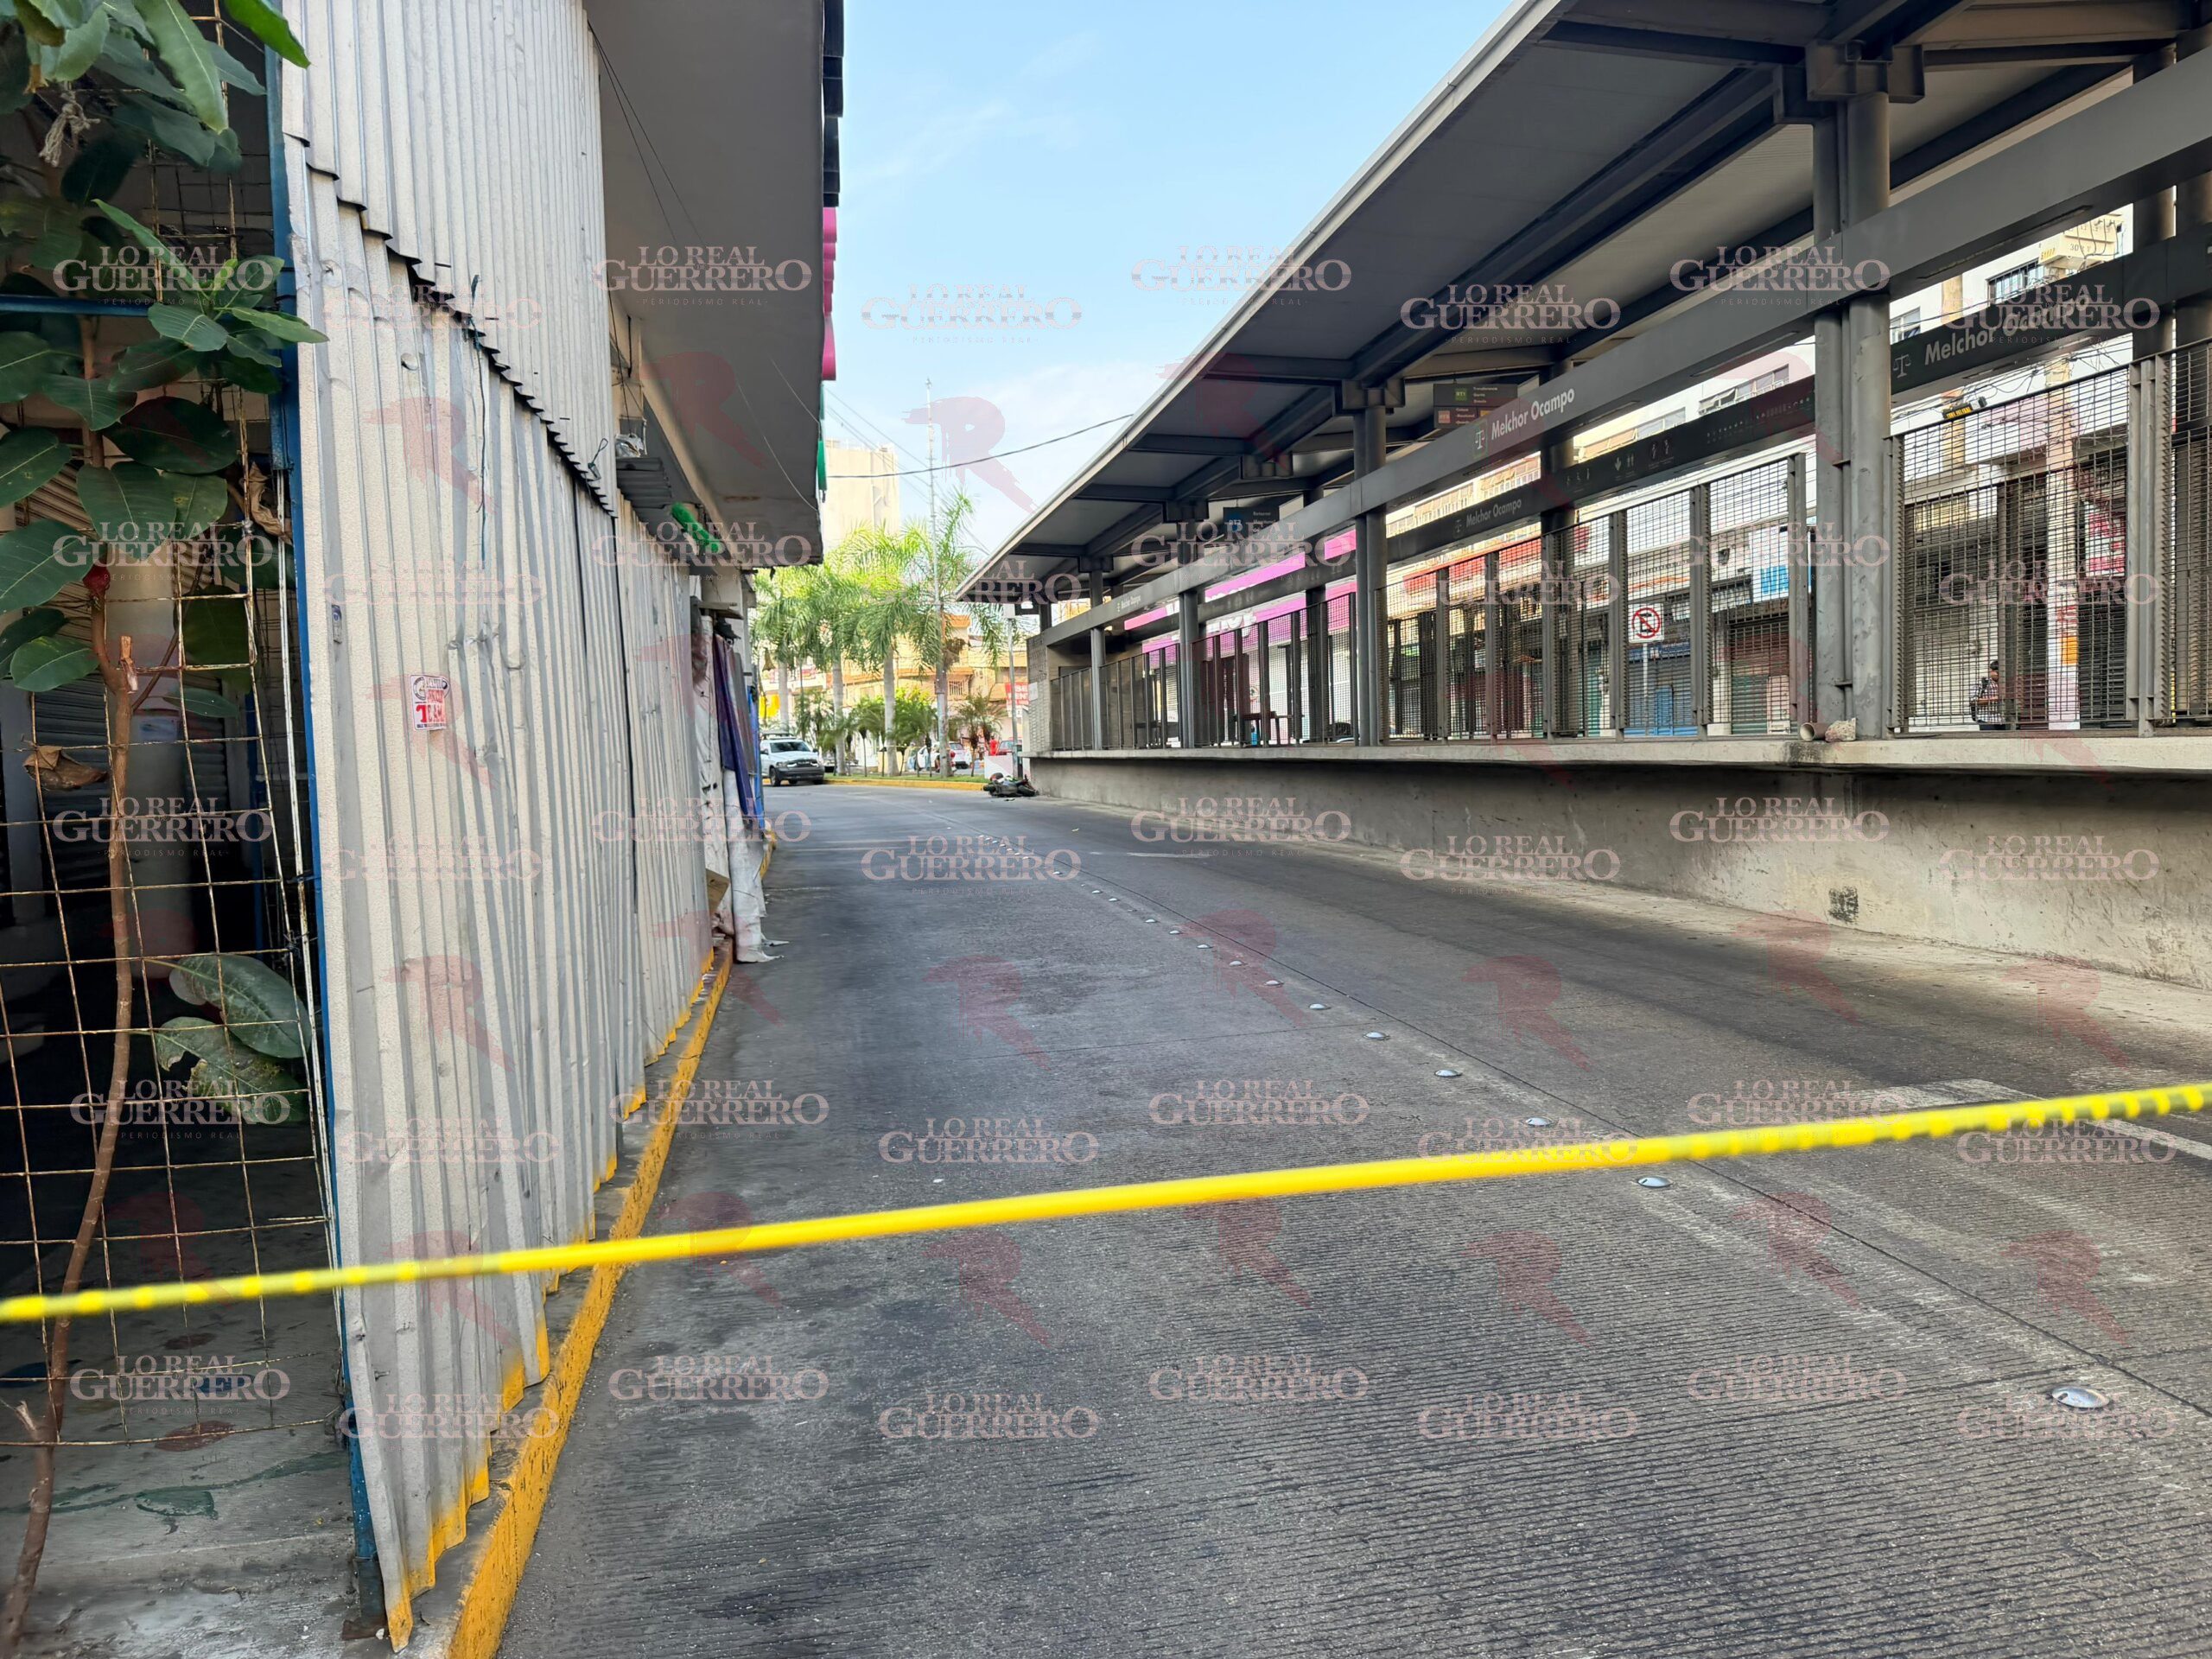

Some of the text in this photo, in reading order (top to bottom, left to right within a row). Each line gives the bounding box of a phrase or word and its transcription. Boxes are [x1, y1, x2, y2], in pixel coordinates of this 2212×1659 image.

[1924, 327, 1997, 365] Melchor
[1491, 410, 1529, 440] Melchor
[1531, 388, 1575, 420] Ocampo
[1466, 499, 1522, 527] Melchor Ocampo
